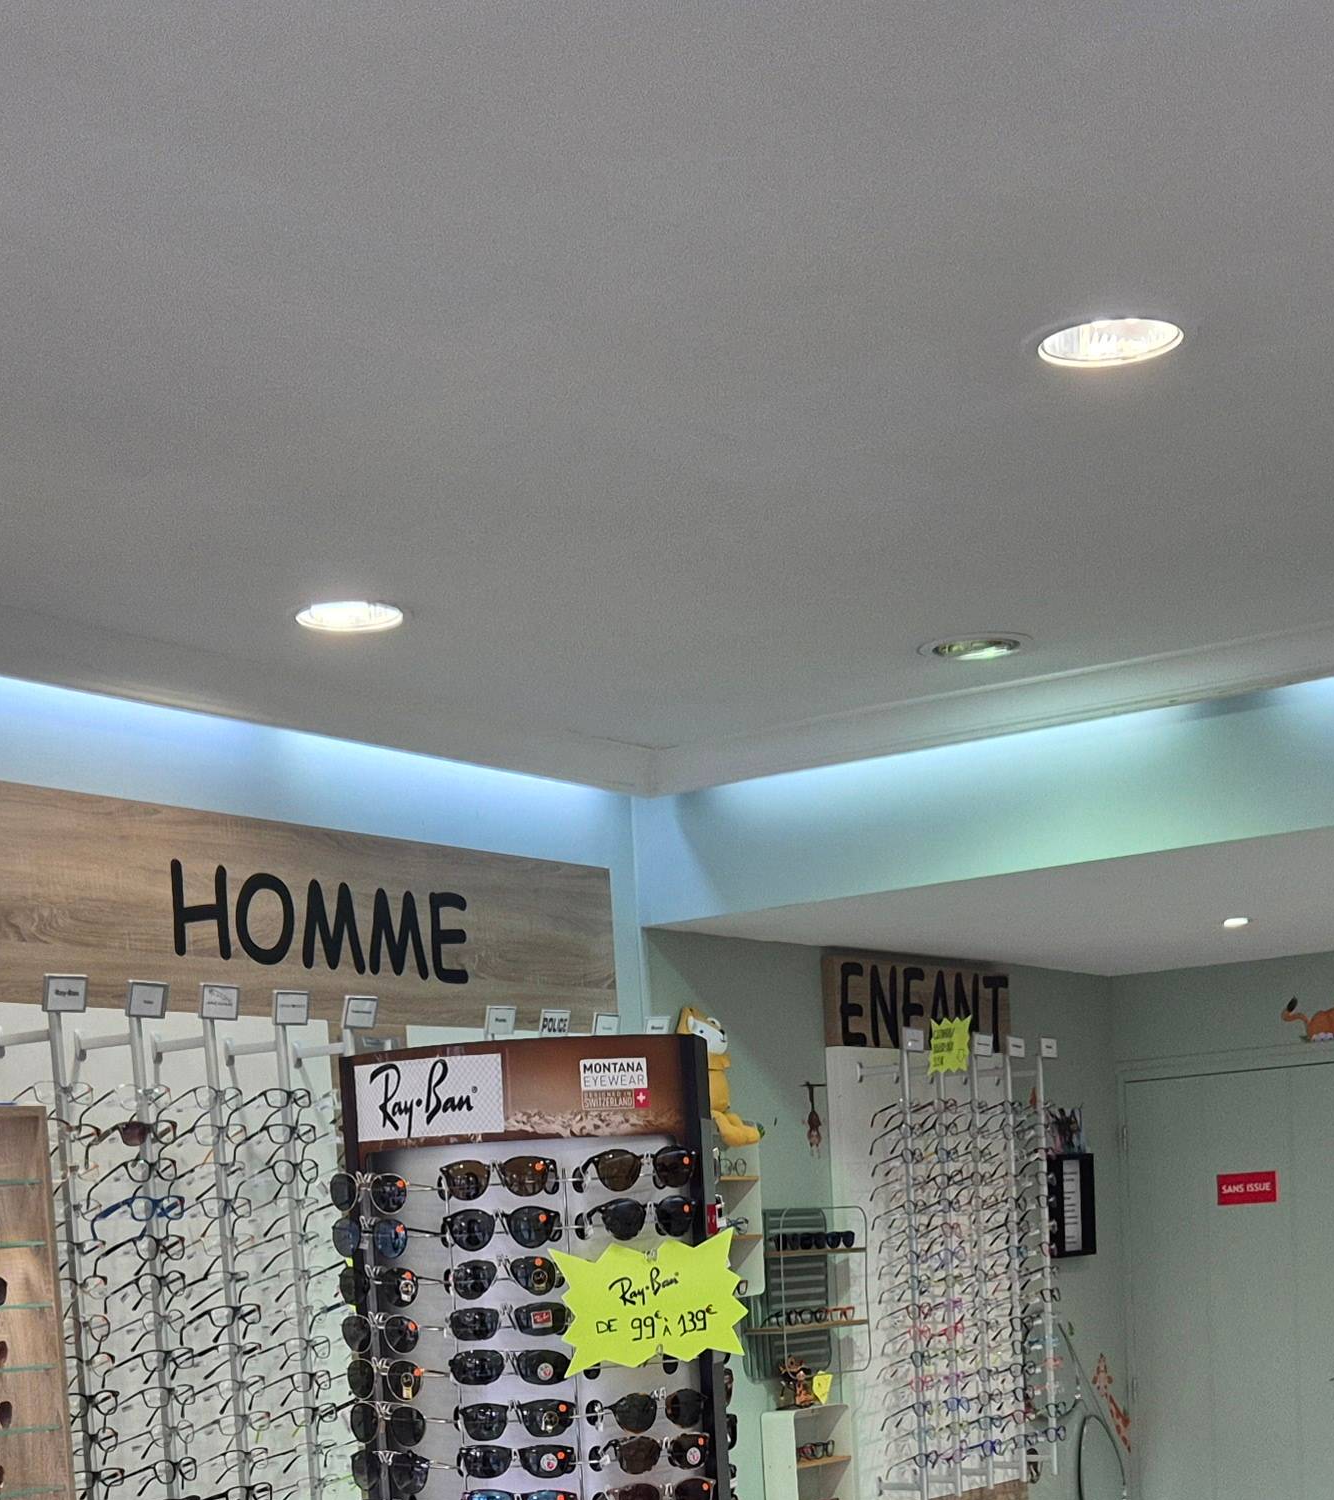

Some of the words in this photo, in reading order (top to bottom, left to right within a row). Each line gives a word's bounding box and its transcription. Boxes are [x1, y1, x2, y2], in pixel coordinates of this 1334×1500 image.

[170, 858, 468, 985] HOMME
[840, 962, 1009, 1053] ENFANT
[540, 1017, 568, 1033] POLICE
[583, 1062, 643, 1074] MONTANA
[583, 1073, 644, 1088] EYEWEAR
[584, 1096, 634, 1108] SWITZERLAND
[1221, 1183, 1245, 1194] SANS
[1246, 1182, 1272, 1192] ISSUE
[595, 1318, 618, 1334] DE
